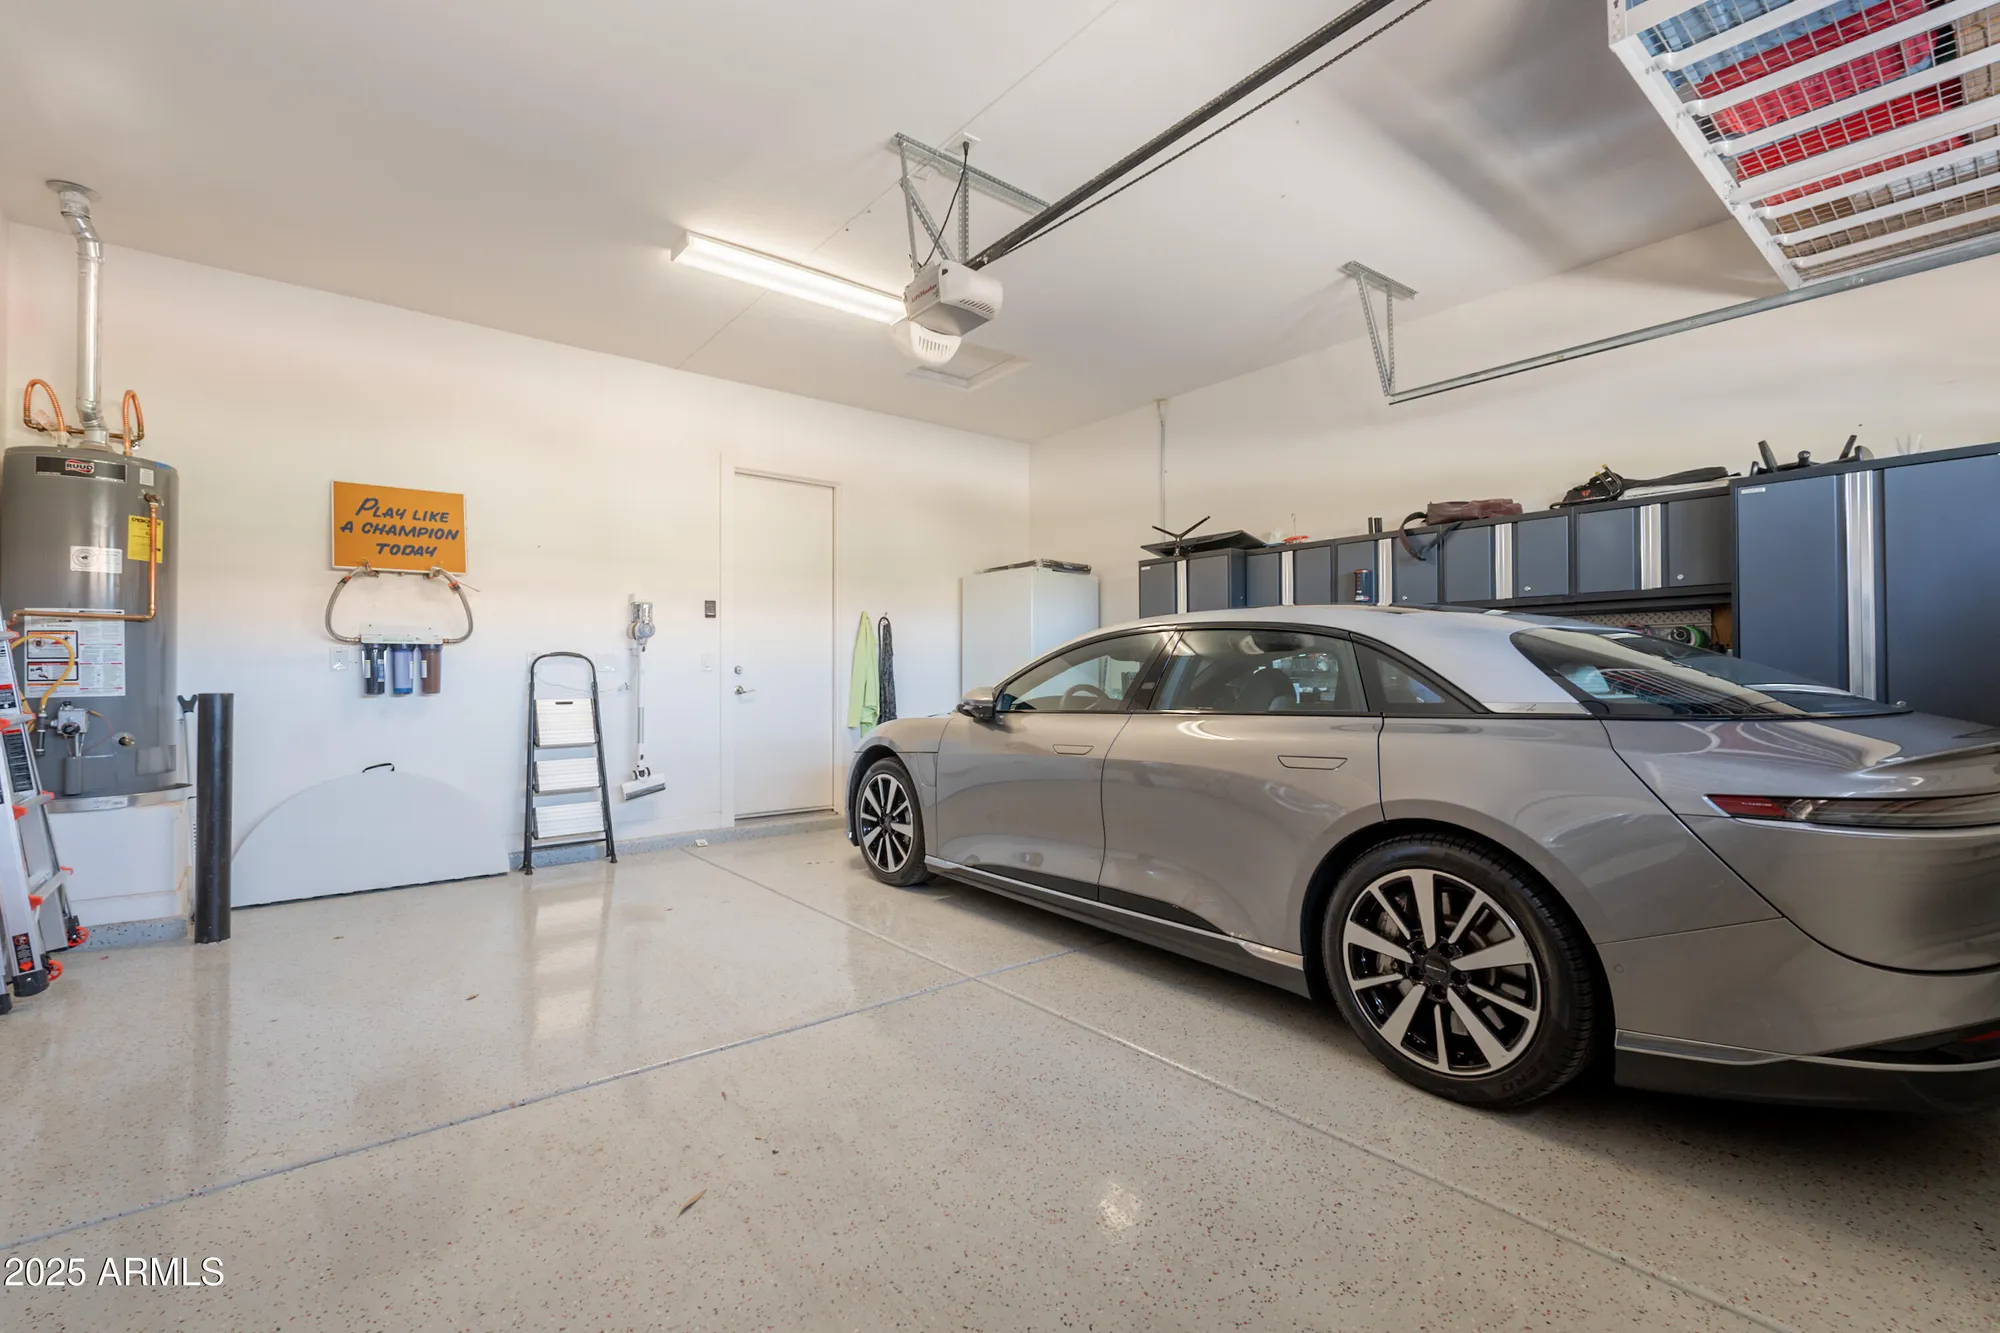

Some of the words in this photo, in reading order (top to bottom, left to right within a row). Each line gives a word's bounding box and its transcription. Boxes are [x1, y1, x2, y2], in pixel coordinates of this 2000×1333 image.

[66, 462, 94, 471] RUUD
[355, 497, 407, 520] PLAY
[412, 509, 450, 523] LIKE
[340, 520, 354, 533] A
[361, 521, 459, 541] CHAMPION
[376, 543, 438, 557] TODAY
